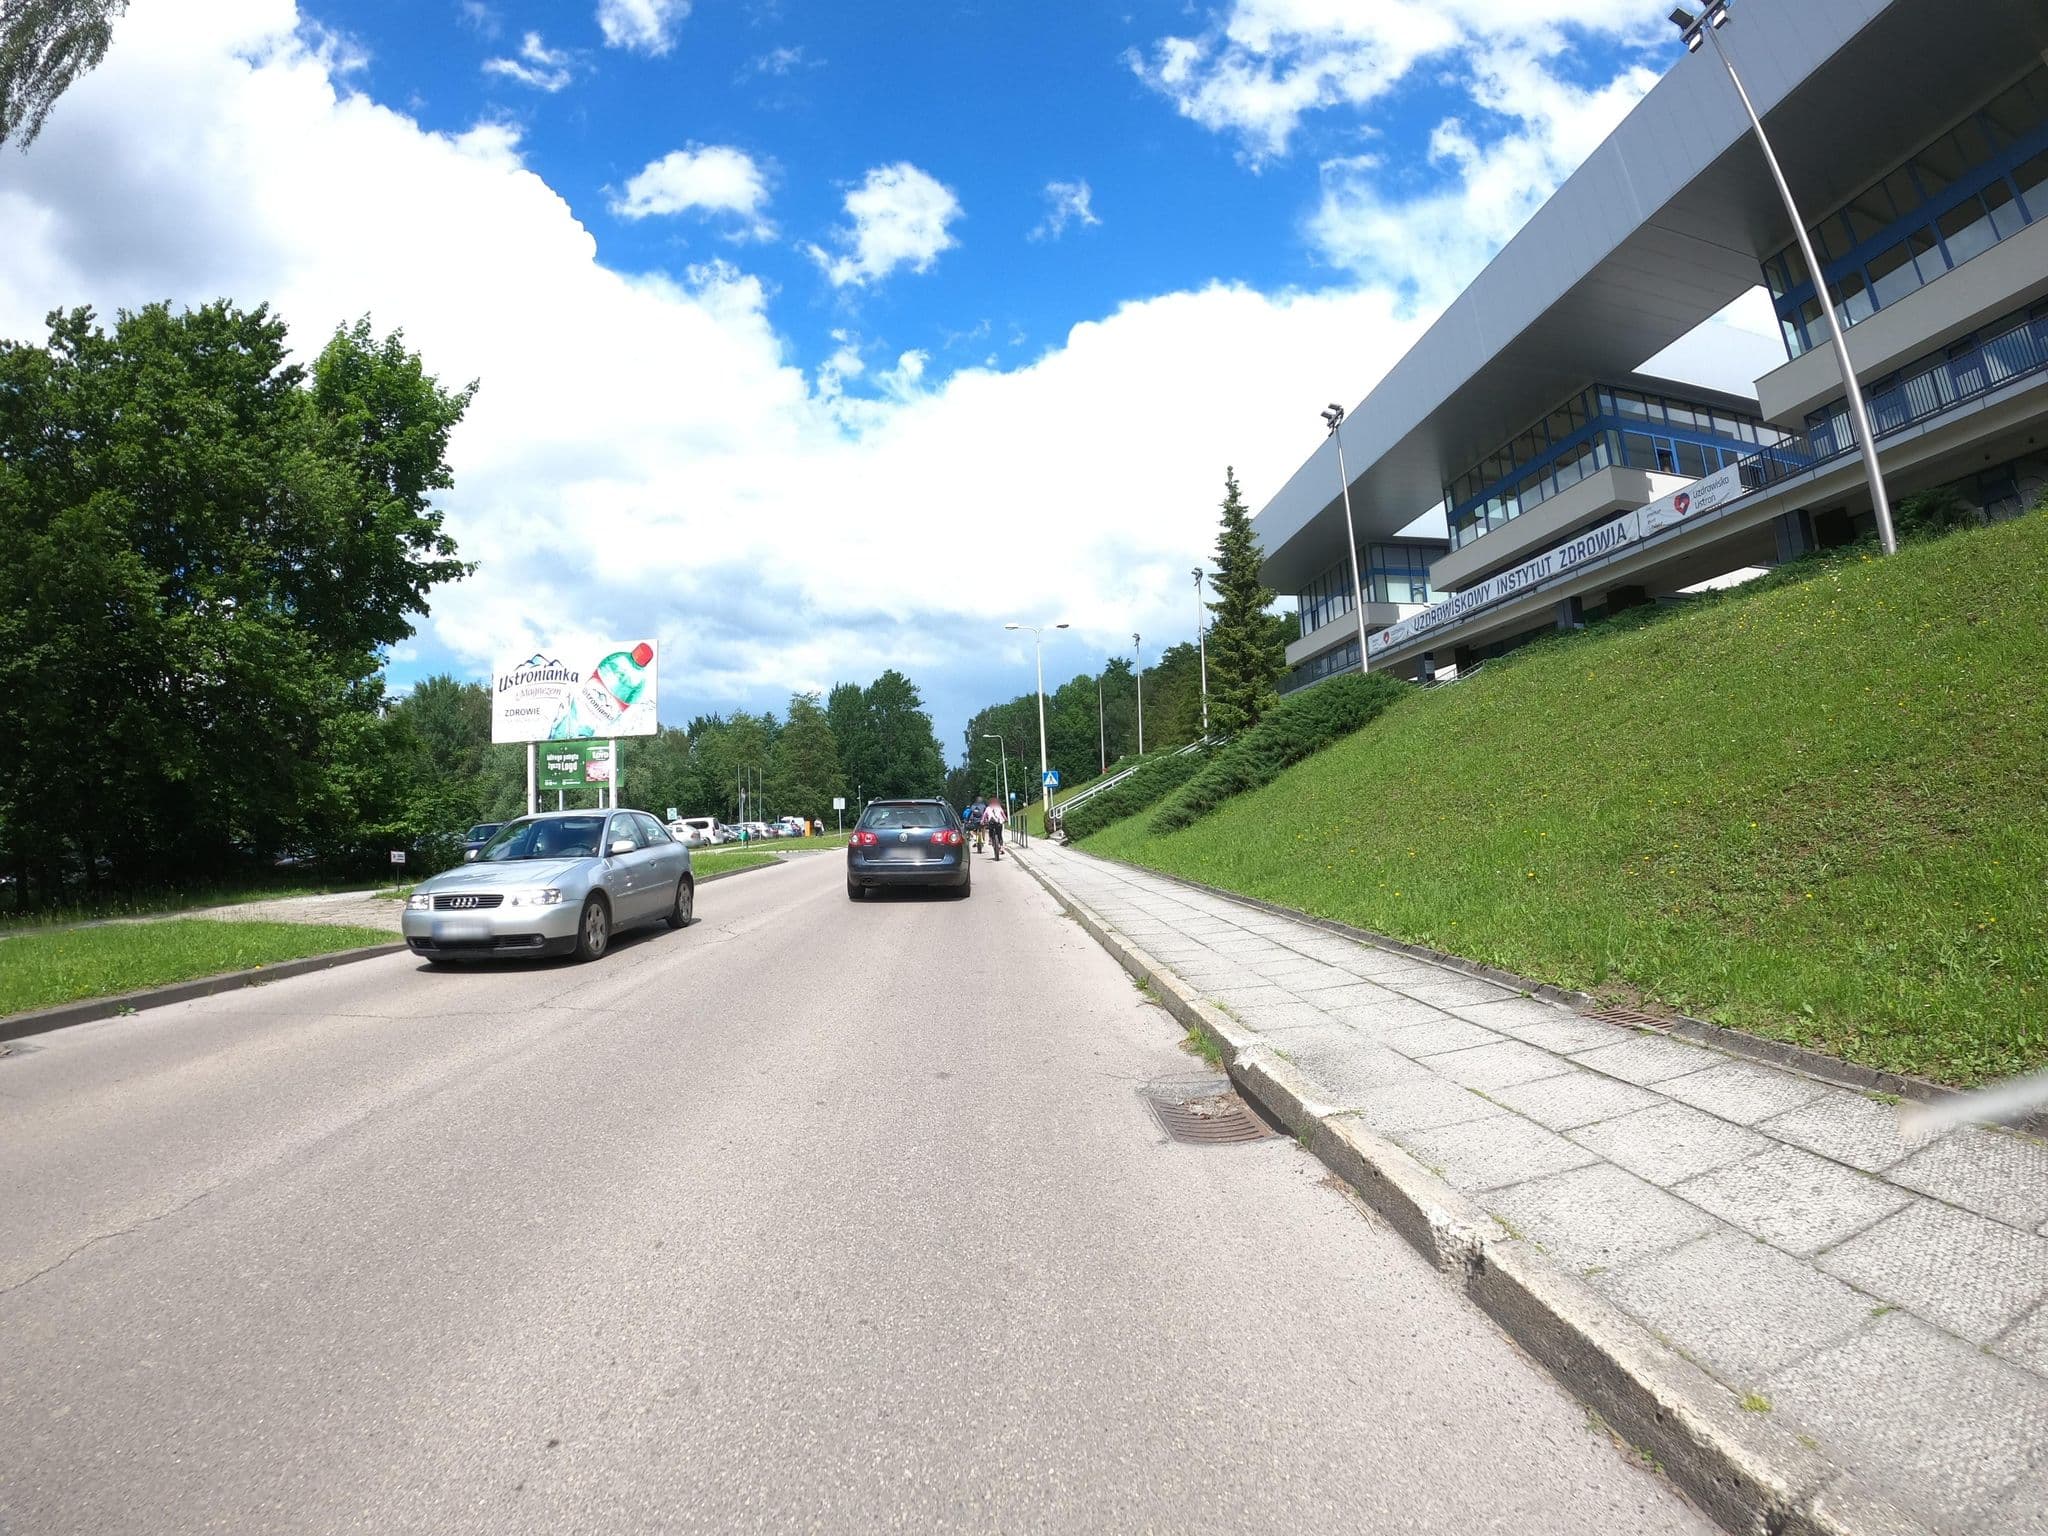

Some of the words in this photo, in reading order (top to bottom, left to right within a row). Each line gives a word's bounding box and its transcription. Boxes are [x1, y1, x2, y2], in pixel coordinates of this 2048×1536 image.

[1692, 476, 1730, 498] Uzdrowisko
[1413, 583, 1491, 630] UZDROWISKOWY
[1497, 556, 1552, 595] INSTYTUT
[1559, 522, 1627, 569] ZDROWIA
[499, 665, 579, 692] Ustronianka
[504, 708, 540, 717] ZDROWIE
